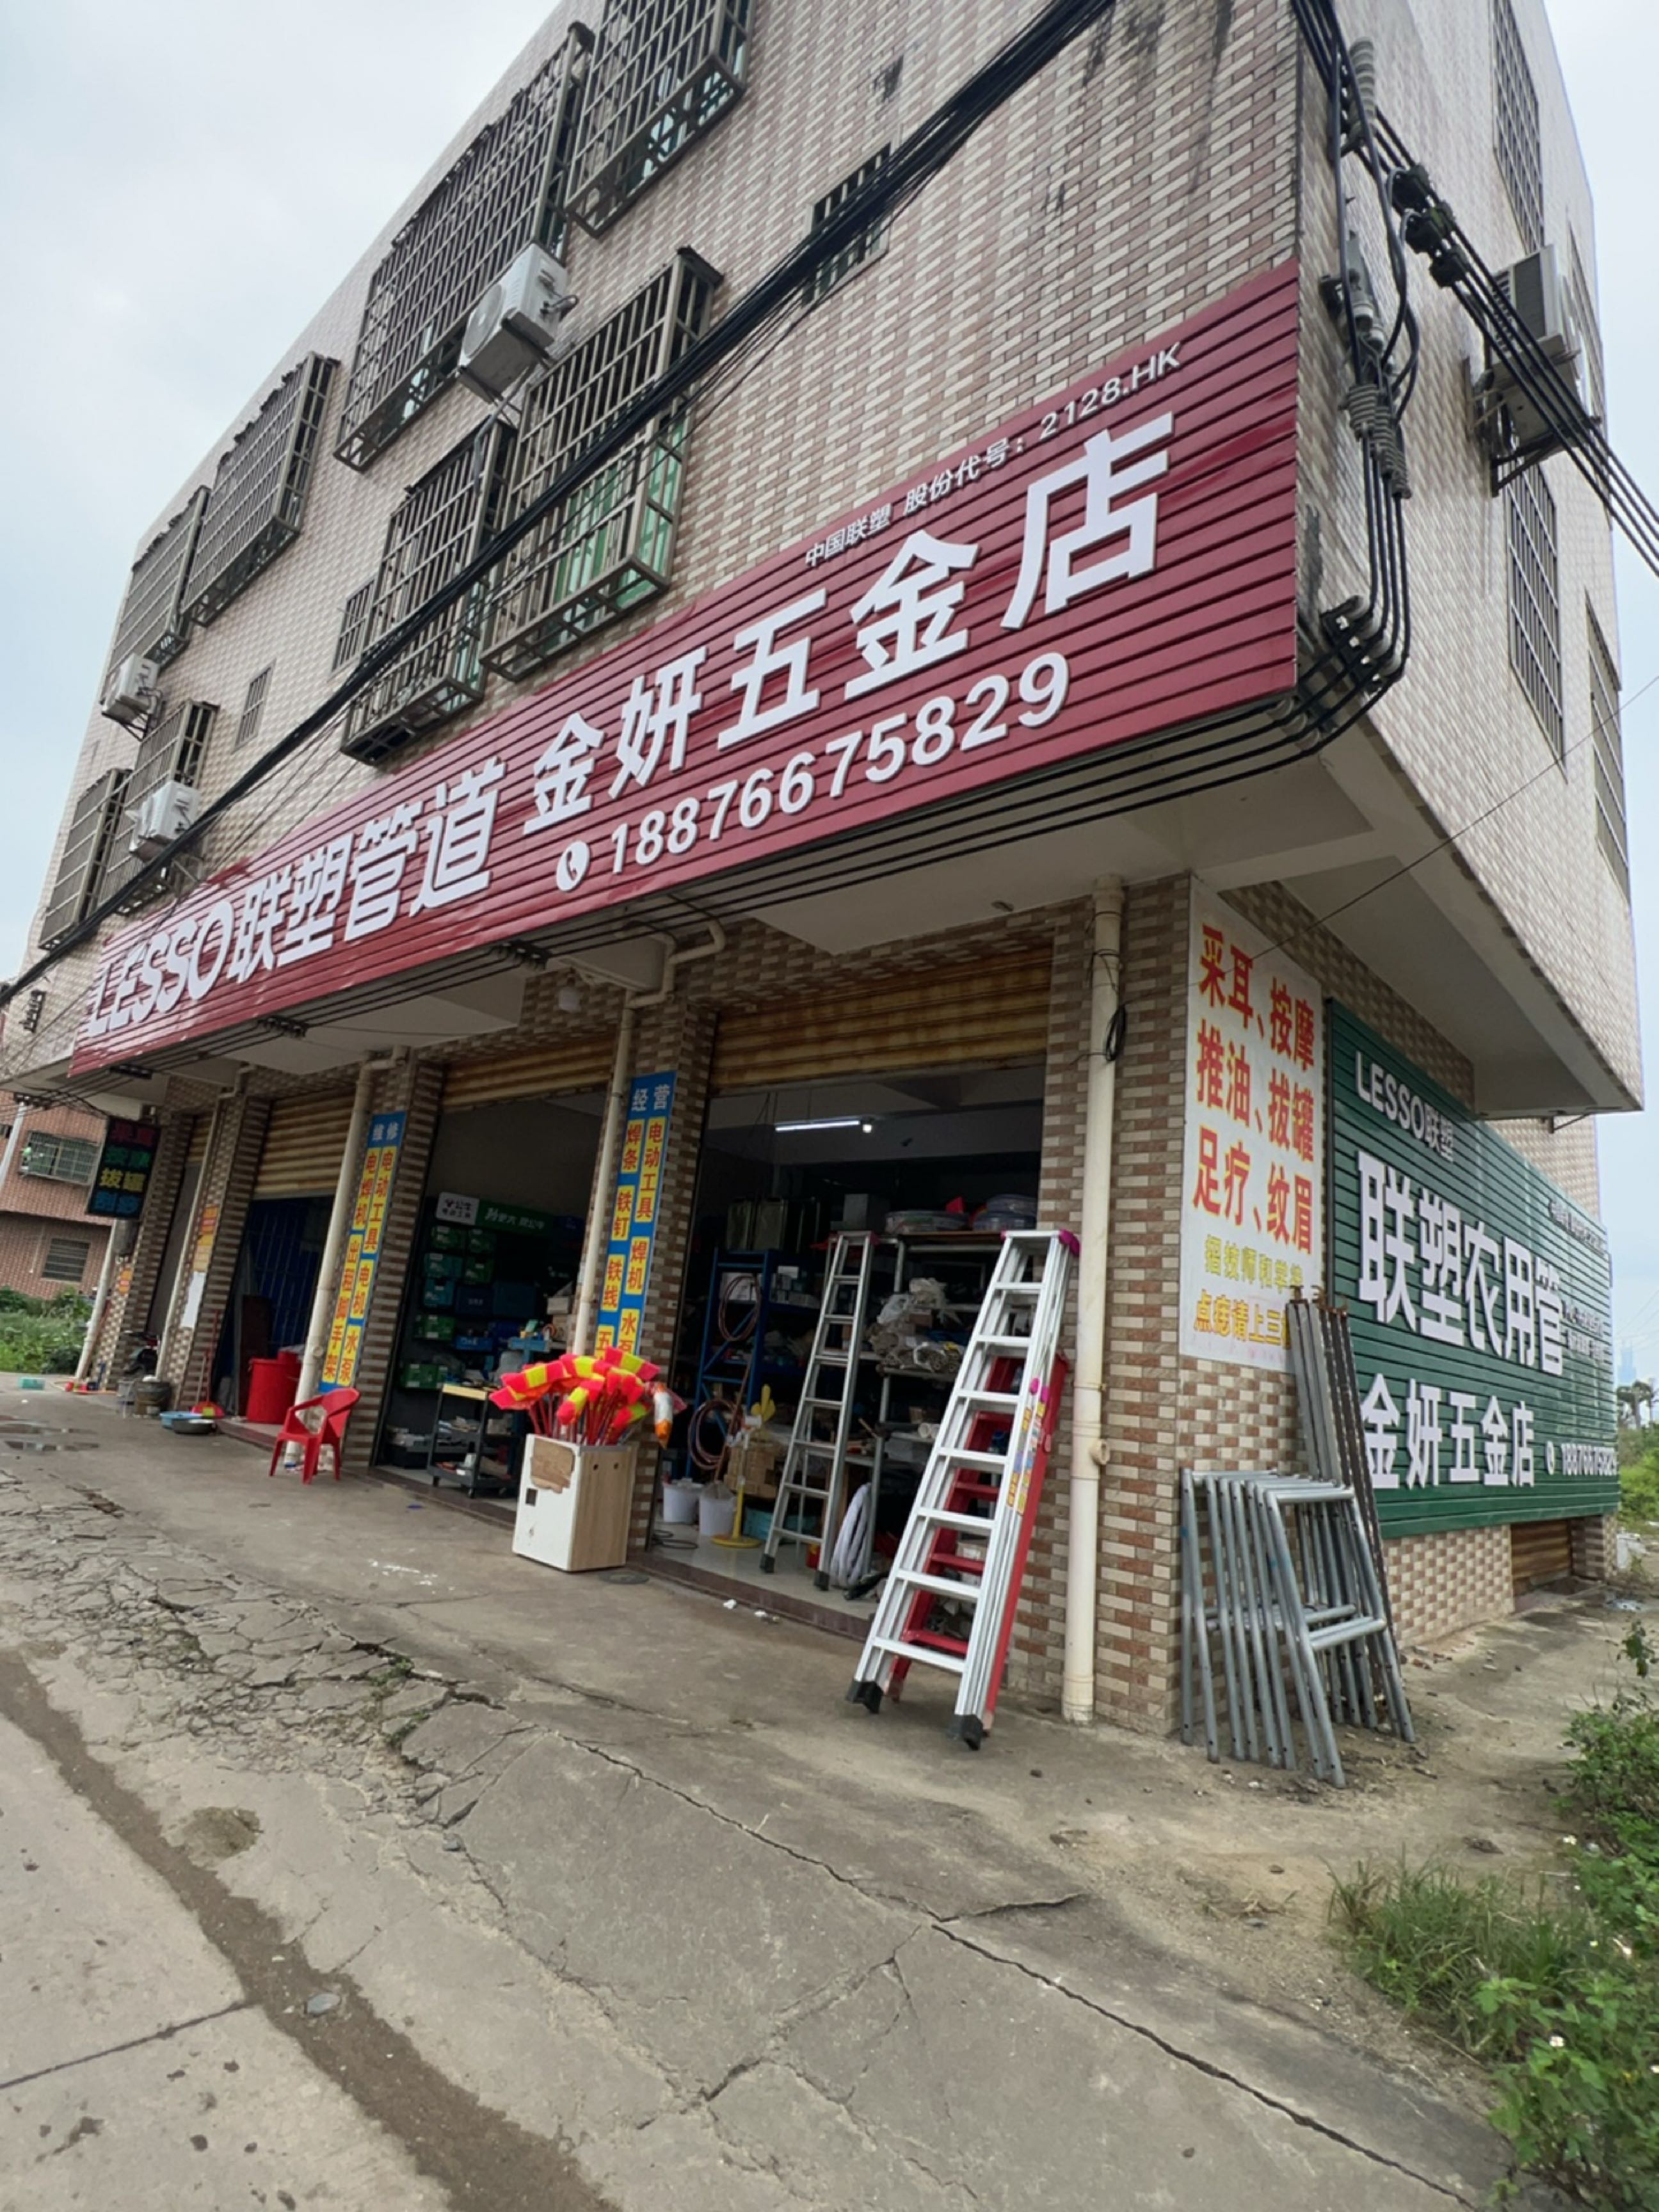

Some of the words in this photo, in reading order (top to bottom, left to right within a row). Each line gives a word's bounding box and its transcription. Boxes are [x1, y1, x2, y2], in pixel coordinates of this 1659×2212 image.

[805, 502, 892, 567] 中国联塑
[1040, 341, 1182, 440] 2128.HK
[86, 755, 508, 1038] LESSO联塑管道
[523, 412, 1174, 836] 金妍五金店
[611, 652, 1070, 874] 18876675829
[1198, 923, 1315, 1072] 采耳、按摩
[622, 1123, 641, 1171] 焊条
[631, 1084, 669, 1112] 经营
[1196, 1018, 1315, 1162] 推油、拔罐
[1356, 1050, 1454, 1163] LESSO联塑
[364, 1150, 394, 1250] 电动工具
[612, 1190, 632, 1238] 铁钉
[636, 1121, 664, 1219] 电动工具
[1192, 1125, 1313, 1254] 足疗、纹眉
[603, 1260, 623, 1308] 铁线
[627, 1240, 648, 1290] 焊机
[1358, 1150, 1564, 1376] 联塑农用管
[1361, 1374, 1535, 1490] 金妍五金店
